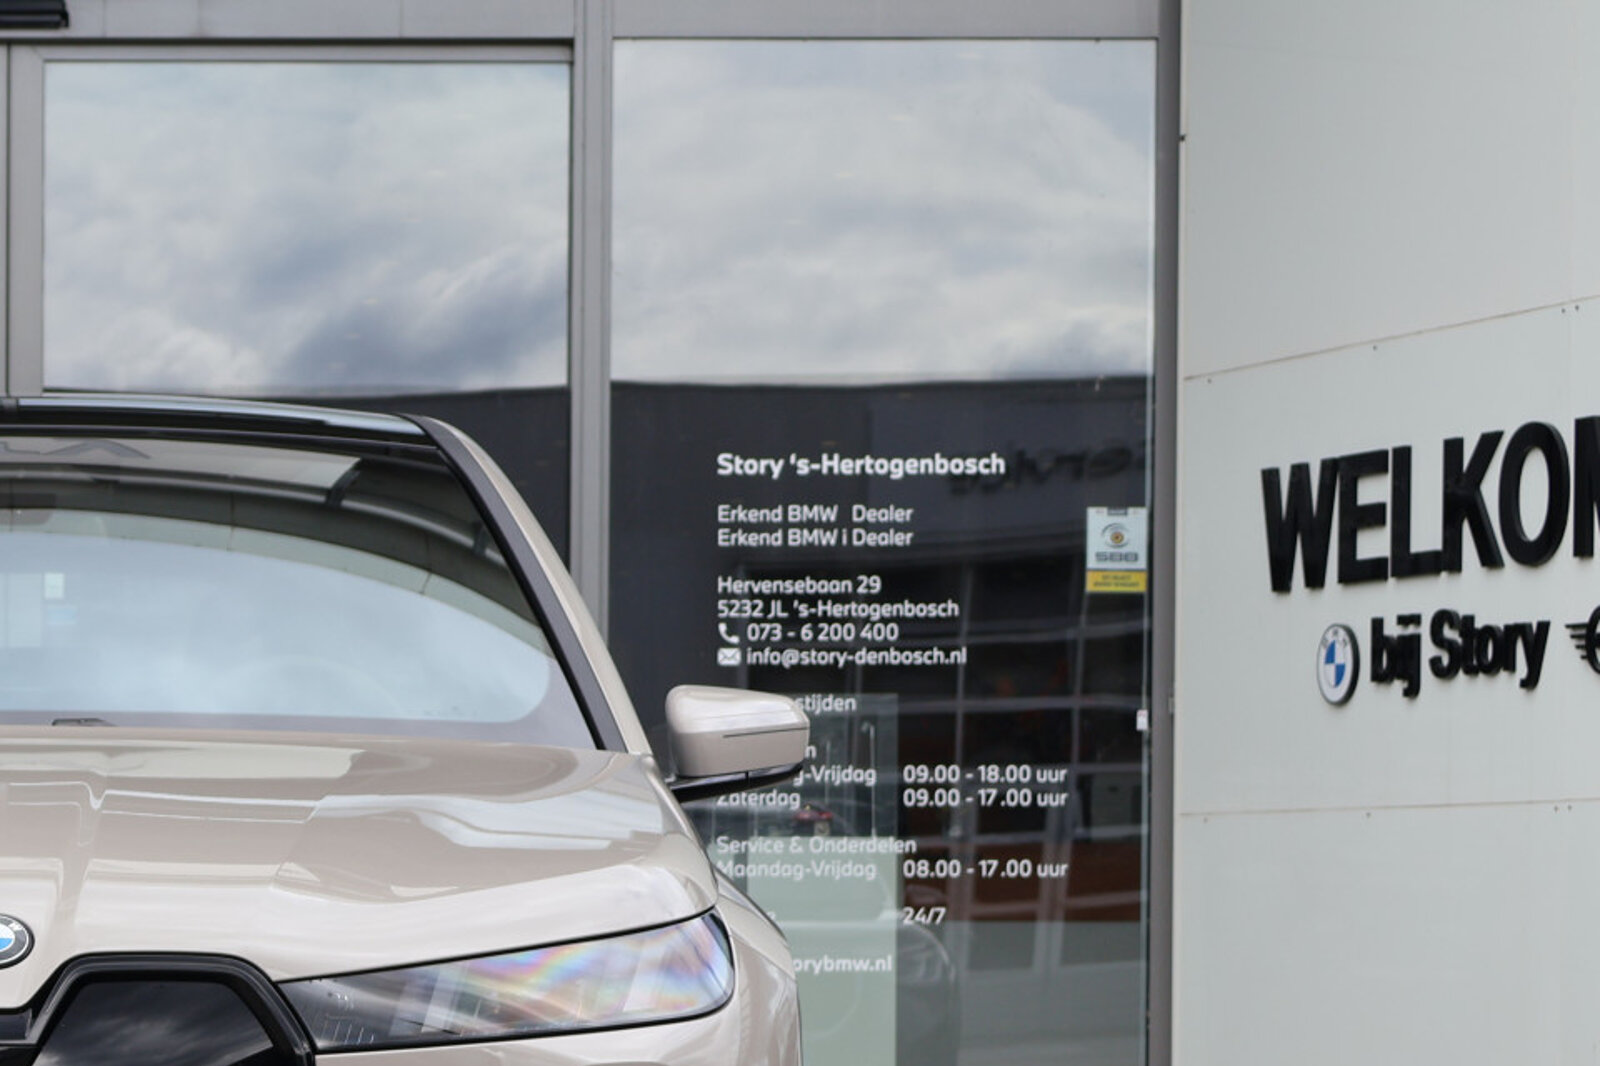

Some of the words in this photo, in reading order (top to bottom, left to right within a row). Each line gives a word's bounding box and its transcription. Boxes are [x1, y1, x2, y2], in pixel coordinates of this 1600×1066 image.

[717, 453, 784, 479] Story
[718, 504, 783, 523] Erkend
[788, 504, 838, 523] BMW
[852, 504, 913, 523] Dealer
[718, 528, 783, 547] Erkend
[788, 528, 838, 547] BMW
[842, 528, 848, 547] i
[852, 528, 913, 547] Dealer
[718, 575, 852, 595] Hervensebaan
[857, 575, 882, 594] 29
[718, 600, 763, 618] 5232
[767, 600, 789, 619] JL
[747, 623, 782, 642] 073
[801, 623, 813, 642] 6
[817, 623, 855, 642] 200
[860, 623, 899, 642] 400
[747, 646, 967, 668] info@story-denbosch.nl
[1370, 613, 1421, 699] bij
[1429, 608, 1550, 690] Story
[795, 694, 857, 715] stijden
[793, 764, 877, 787] g-Vrijdag
[903, 764, 960, 783] 09.00
[978, 764, 1031, 783] 18.00
[1036, 768, 1068, 783] uur
[717, 790, 800, 810] Zaterdag
[903, 788, 960, 807] 09.00
[1036, 792, 1068, 807] uur
[716, 836, 784, 853] Service
[789, 836, 803, 853] &
[809, 835, 917, 853] Onderdelen
[717, 860, 877, 880] Maandag-Vrijdag
[903, 859, 961, 878] 08.00
[1036, 863, 1068, 878] uur
[903, 906, 946, 925] 24/7
[793, 954, 892, 975] orybmw.nl
